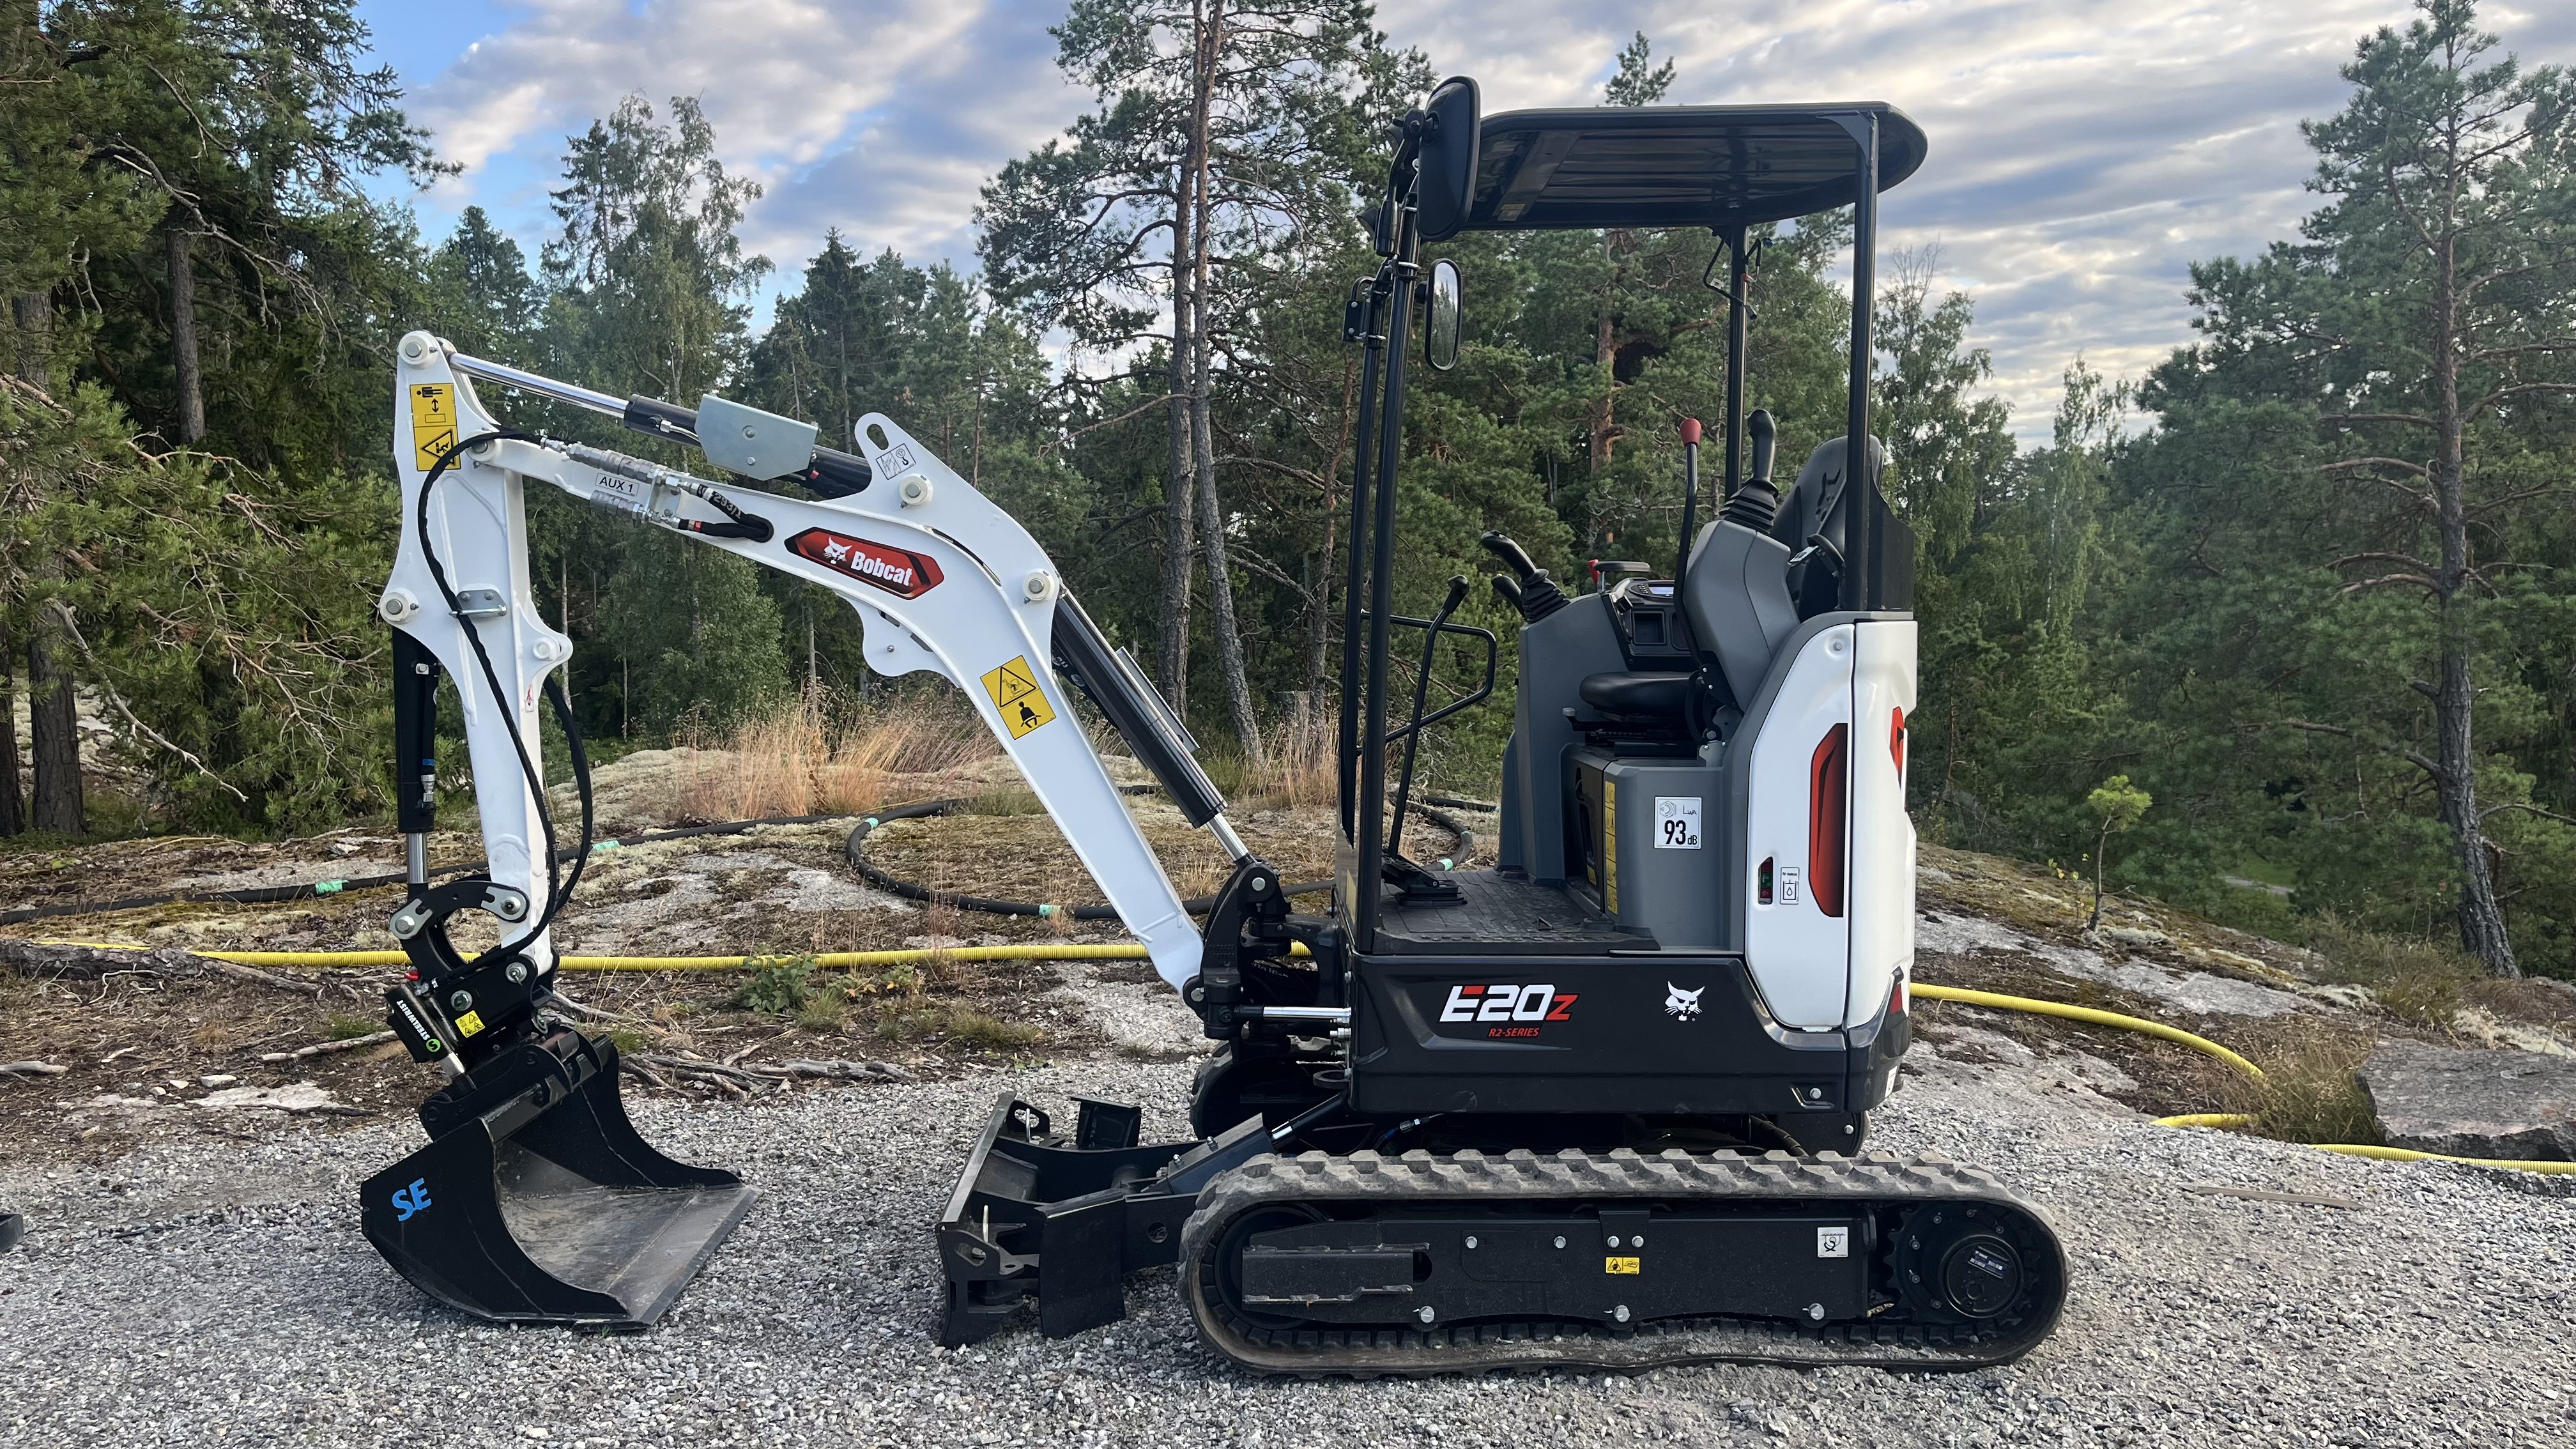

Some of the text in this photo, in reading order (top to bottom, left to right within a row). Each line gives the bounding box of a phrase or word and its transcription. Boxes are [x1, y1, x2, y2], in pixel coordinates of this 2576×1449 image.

[599, 476, 633, 493] AUX 1
[850, 551, 912, 586] Bobcat
[1664, 820, 1698, 845] 93 dB
[396, 999, 431, 1041] STEELWRIST
[1488, 1027, 1540, 1038] R2-SERIES
[392, 1177, 432, 1222] SE
